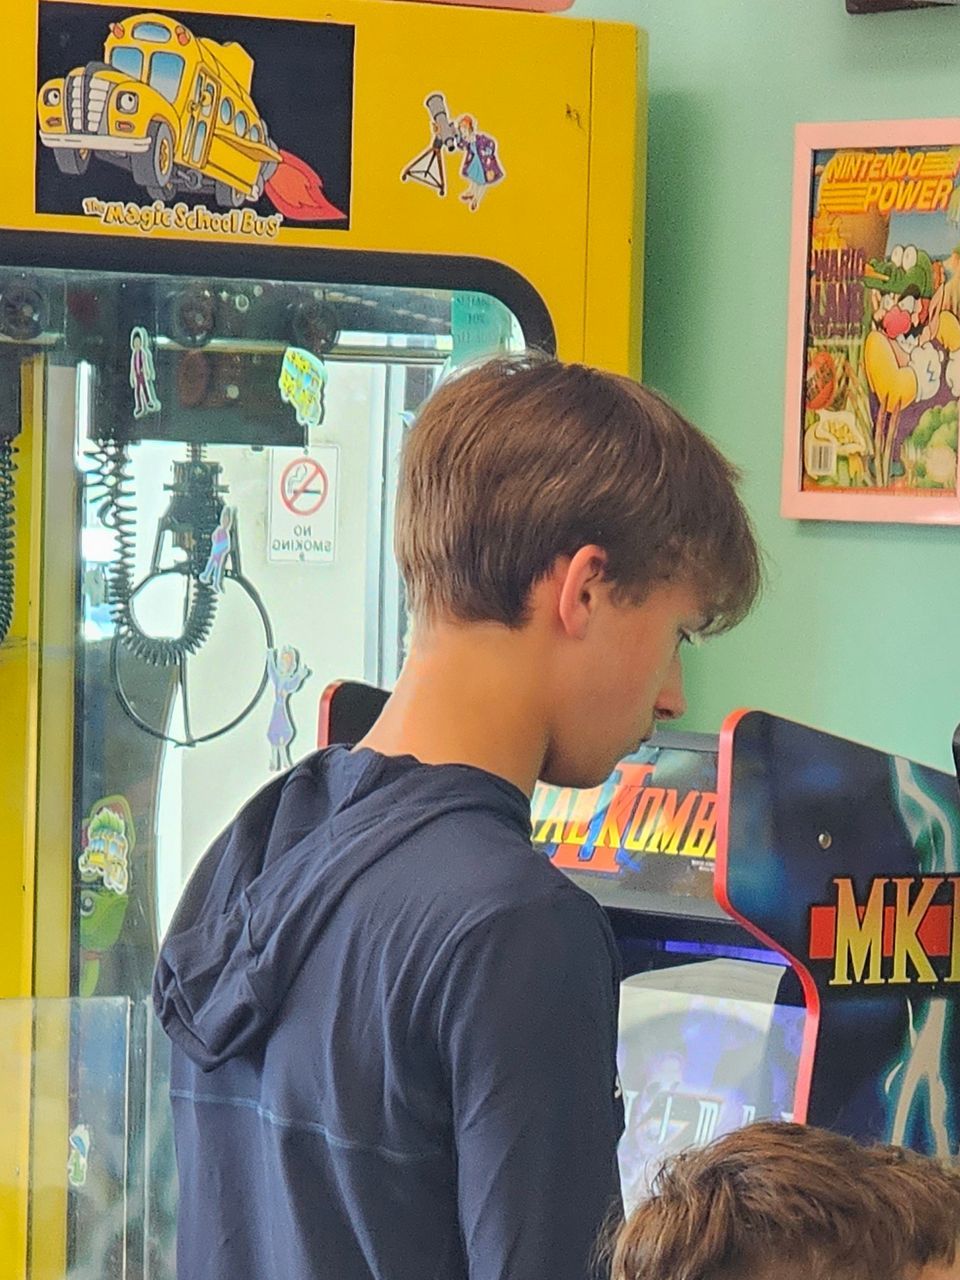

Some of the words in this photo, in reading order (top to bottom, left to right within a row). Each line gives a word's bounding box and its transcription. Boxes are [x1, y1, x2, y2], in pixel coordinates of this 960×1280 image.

[828, 152, 926, 183] NINTENDO
[863, 178, 954, 214] POWER
[103, 203, 171, 229] Magic
[173, 206, 237, 233] School
[239, 212, 279, 237] Bus
[594, 784, 717, 859] KOMB
